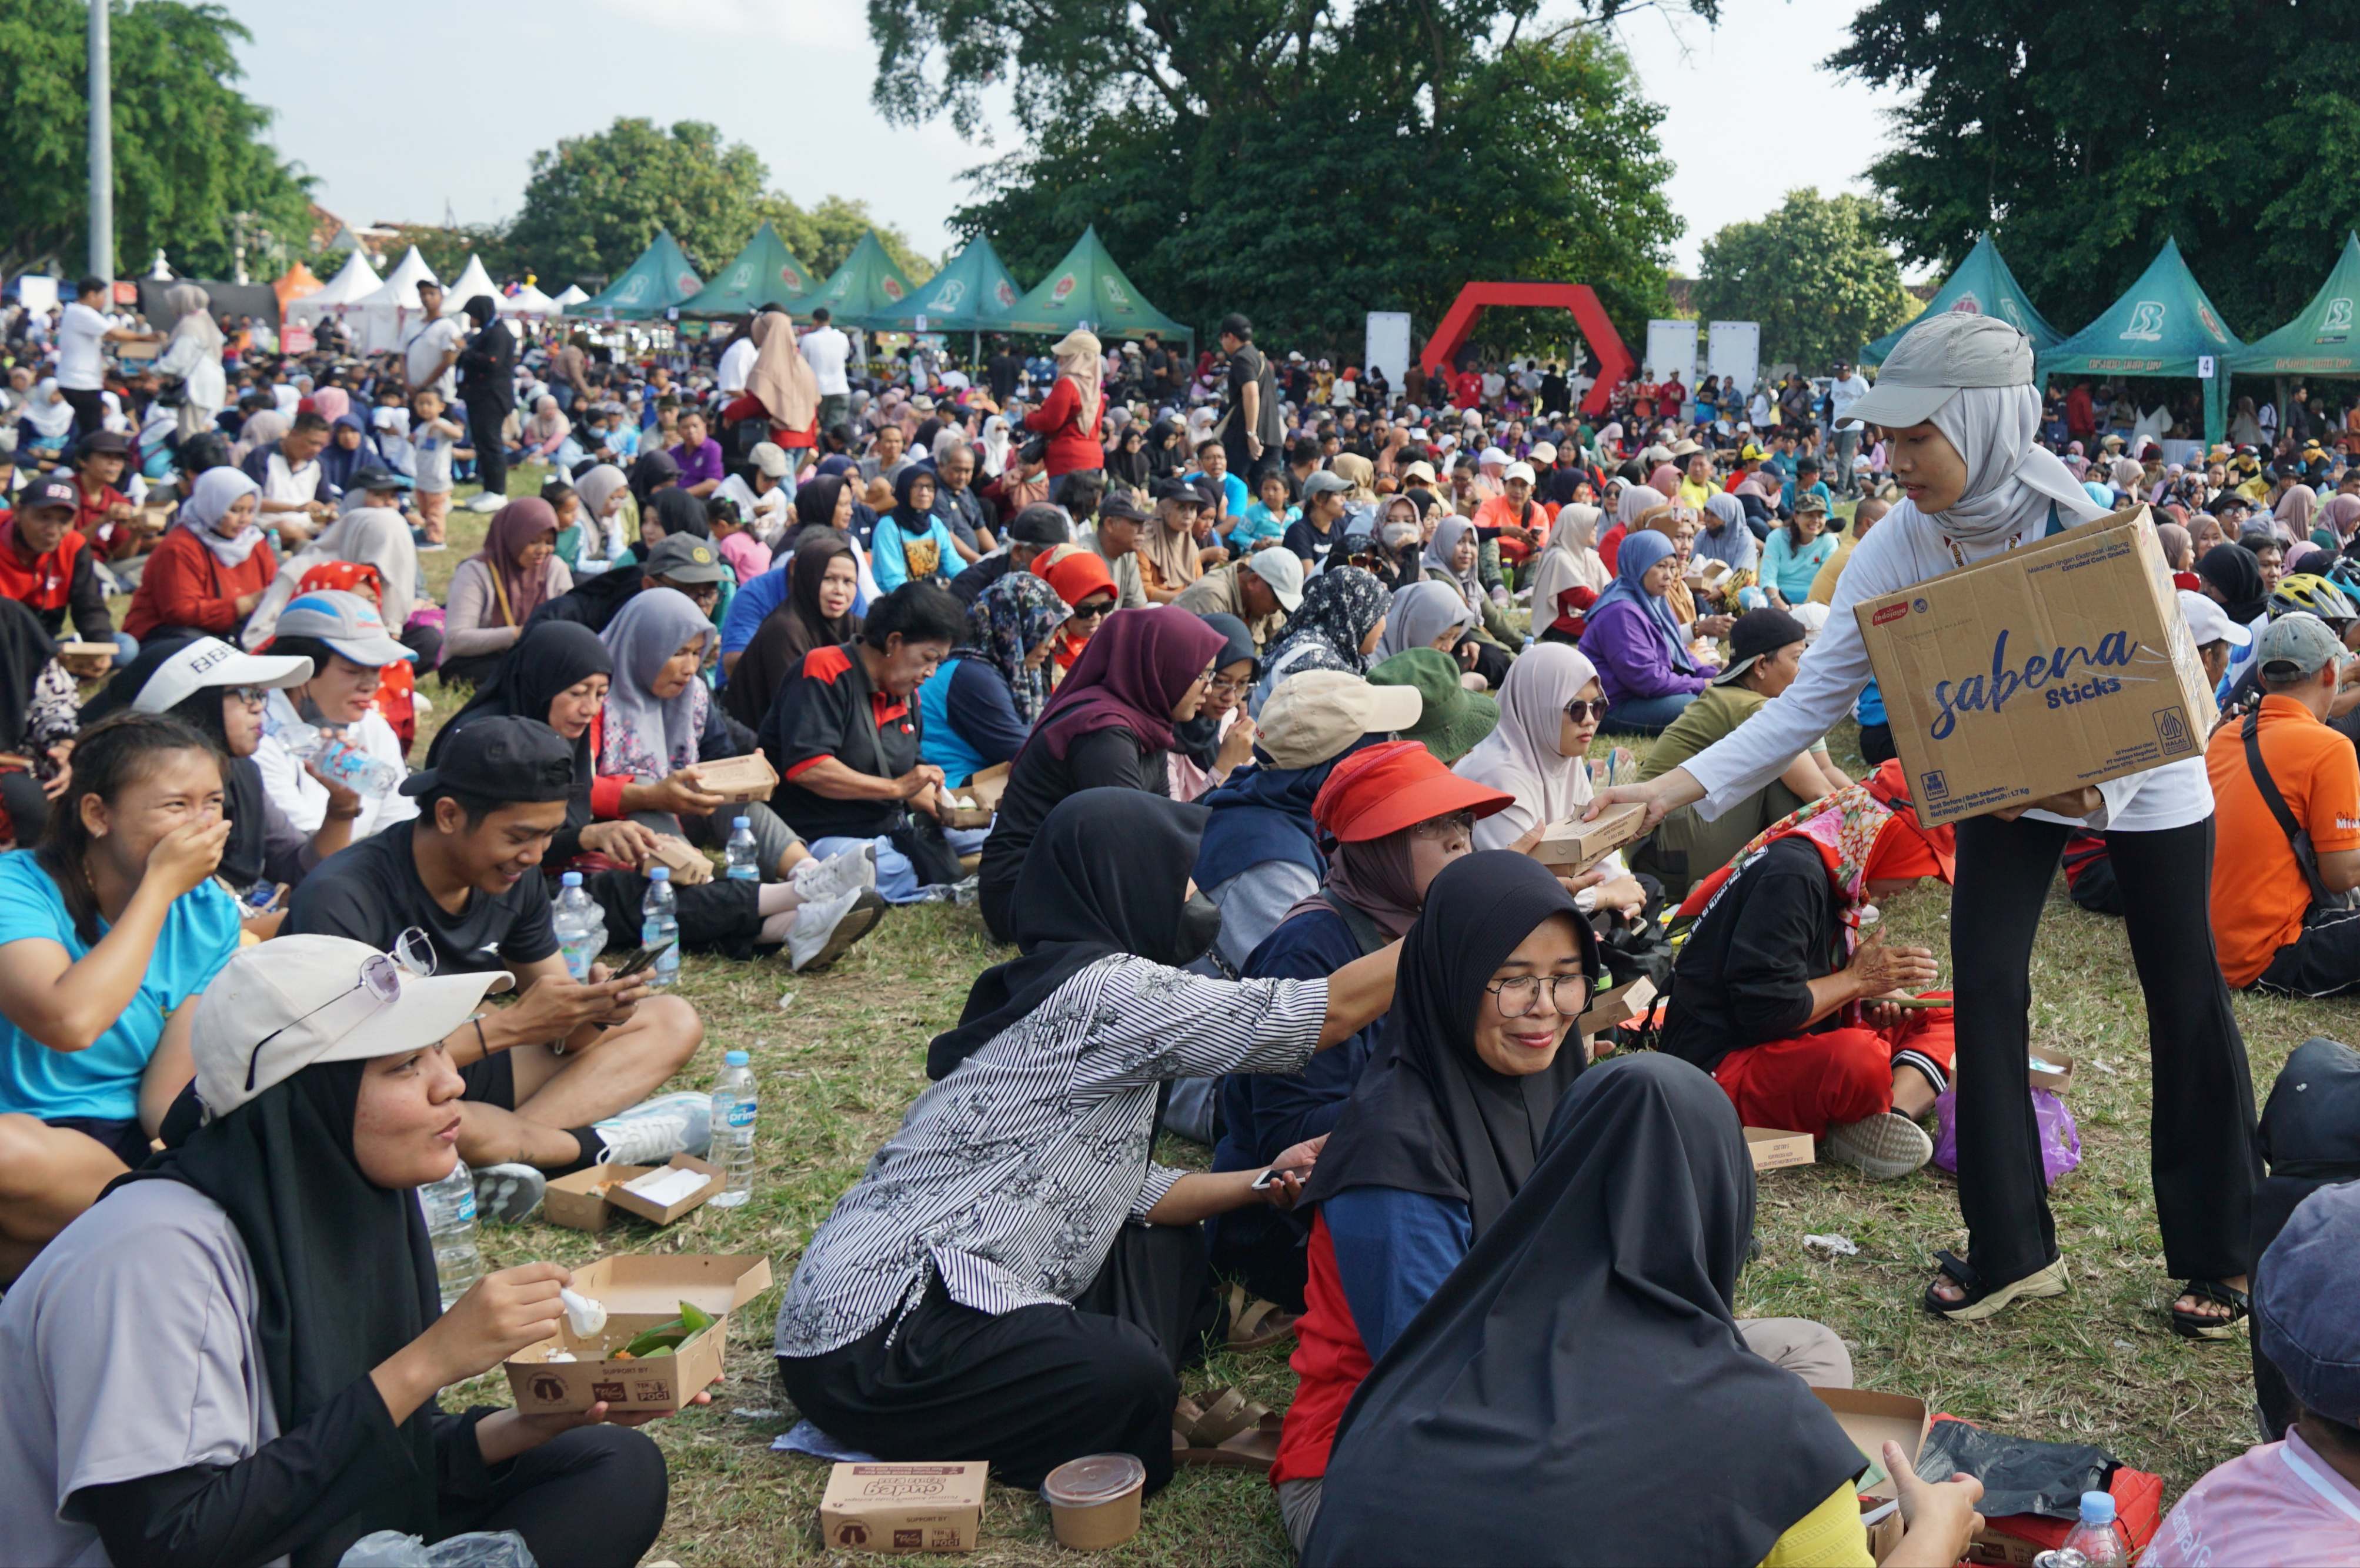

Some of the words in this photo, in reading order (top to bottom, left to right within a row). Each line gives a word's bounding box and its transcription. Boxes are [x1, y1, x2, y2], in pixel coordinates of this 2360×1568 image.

[2203, 359, 2209, 372] 4
[2028, 563, 2055, 574] Makanan
[2055, 557, 2075, 566] ringan
[2062, 559, 2090, 572] Extruded
[2107, 548, 2130, 558] Snacks
[1931, 629, 2138, 740] sabena
[2045, 677, 2121, 709] Sticks
[2165, 738, 2187, 747] HALAL
[1701, 908, 1709, 918] IS
[1691, 915, 1702, 933] THE
[639, 1392, 668, 1400] POCI
[863, 1481, 944, 1496] Gudeg
